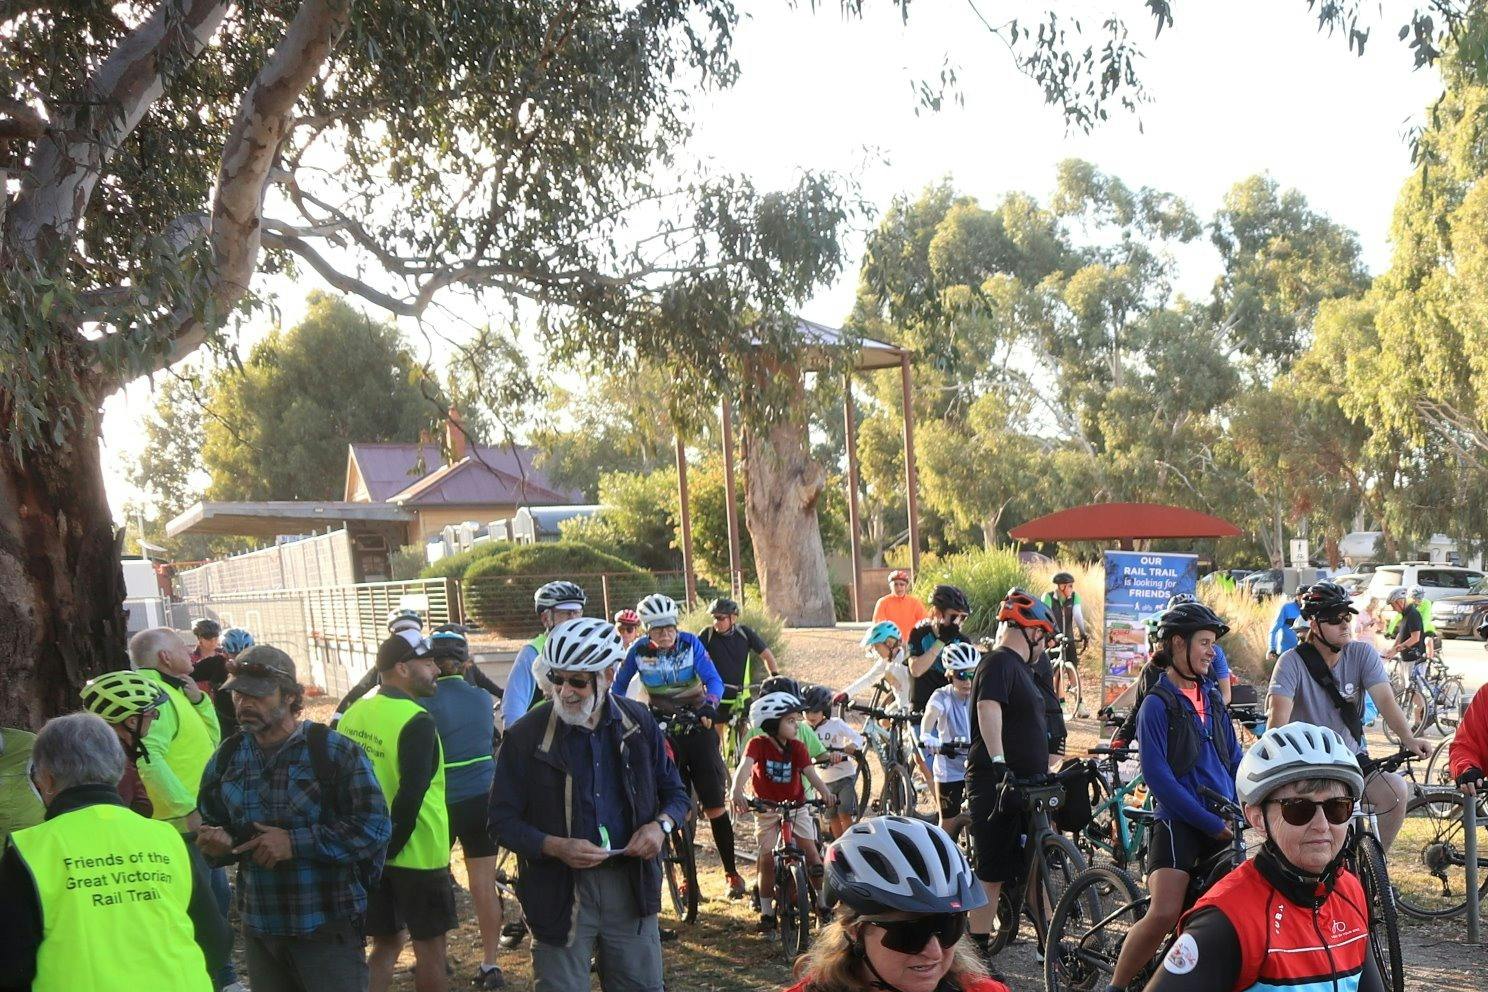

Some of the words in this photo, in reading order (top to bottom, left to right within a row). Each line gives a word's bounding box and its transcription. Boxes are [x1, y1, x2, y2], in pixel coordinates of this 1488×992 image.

[1140, 556, 1162, 566] OUR
[1124, 567, 1147, 576] RAIL
[1150, 568, 1178, 578] TRAIL
[1124, 577, 1132, 587] is
[1133, 577, 1163, 589] looking
[1164, 578, 1177, 589] for
[1129, 589, 1171, 598] FRIENDS
[63, 852, 124, 871] Friends
[129, 852, 144, 865] of
[147, 851, 171, 865] the
[65, 876, 109, 890] Great
[110, 871, 172, 886] Victorian
[92, 890, 123, 907] Rail
